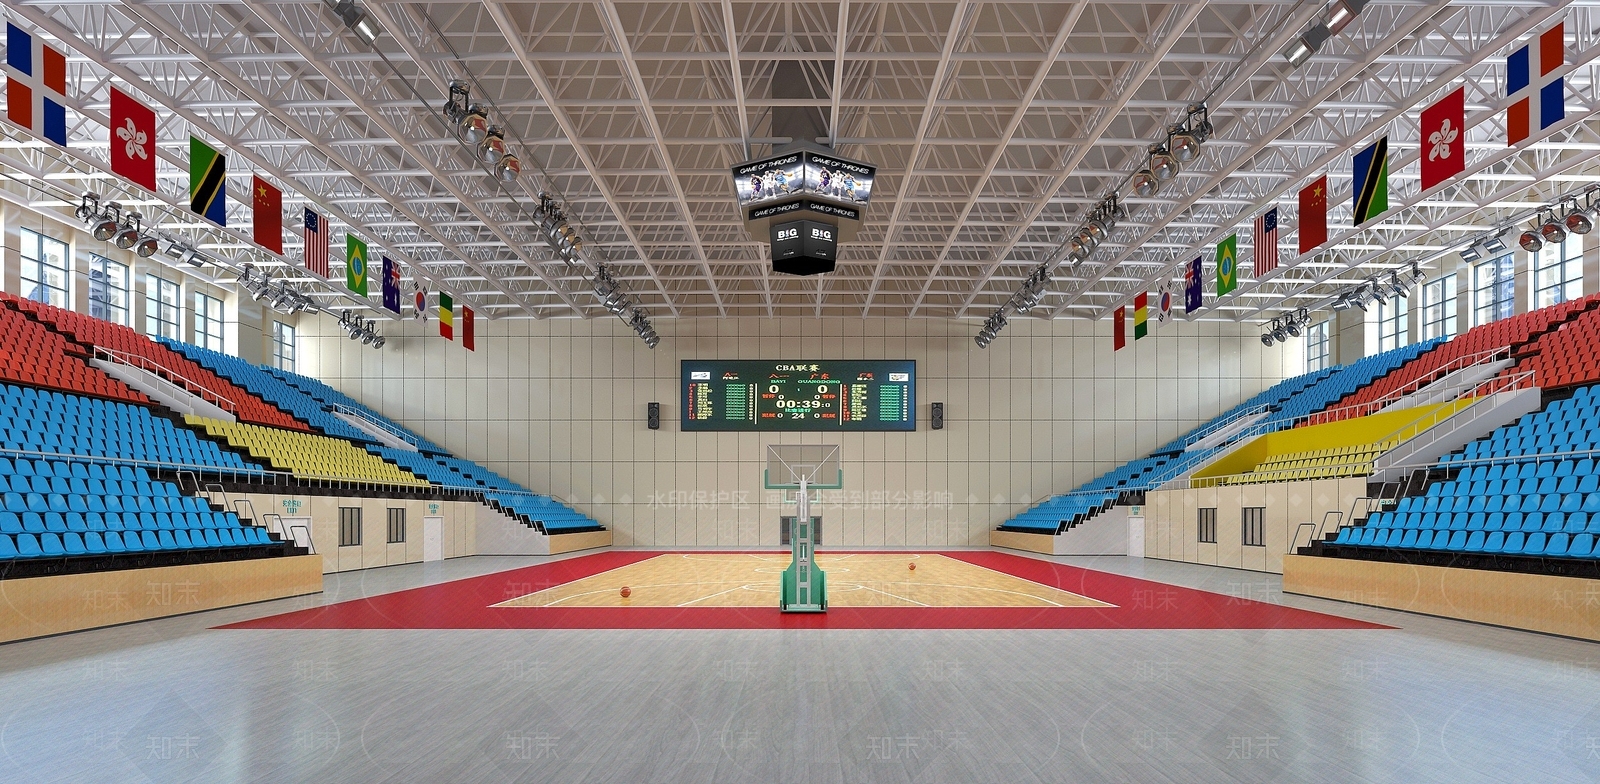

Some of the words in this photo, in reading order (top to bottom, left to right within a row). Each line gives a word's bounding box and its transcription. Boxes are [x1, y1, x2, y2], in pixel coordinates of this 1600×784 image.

[740, 165, 757, 174] GAME
[768, 156, 797, 168] THRONES
[812, 156, 831, 166] GAME
[841, 163, 869, 174] THRONES
[776, 203, 800, 212] THRONES
[810, 203, 825, 211] GAME
[832, 207, 855, 217] THRONES
[769, 385, 780, 394] 0
[817, 385, 828, 394] 0
